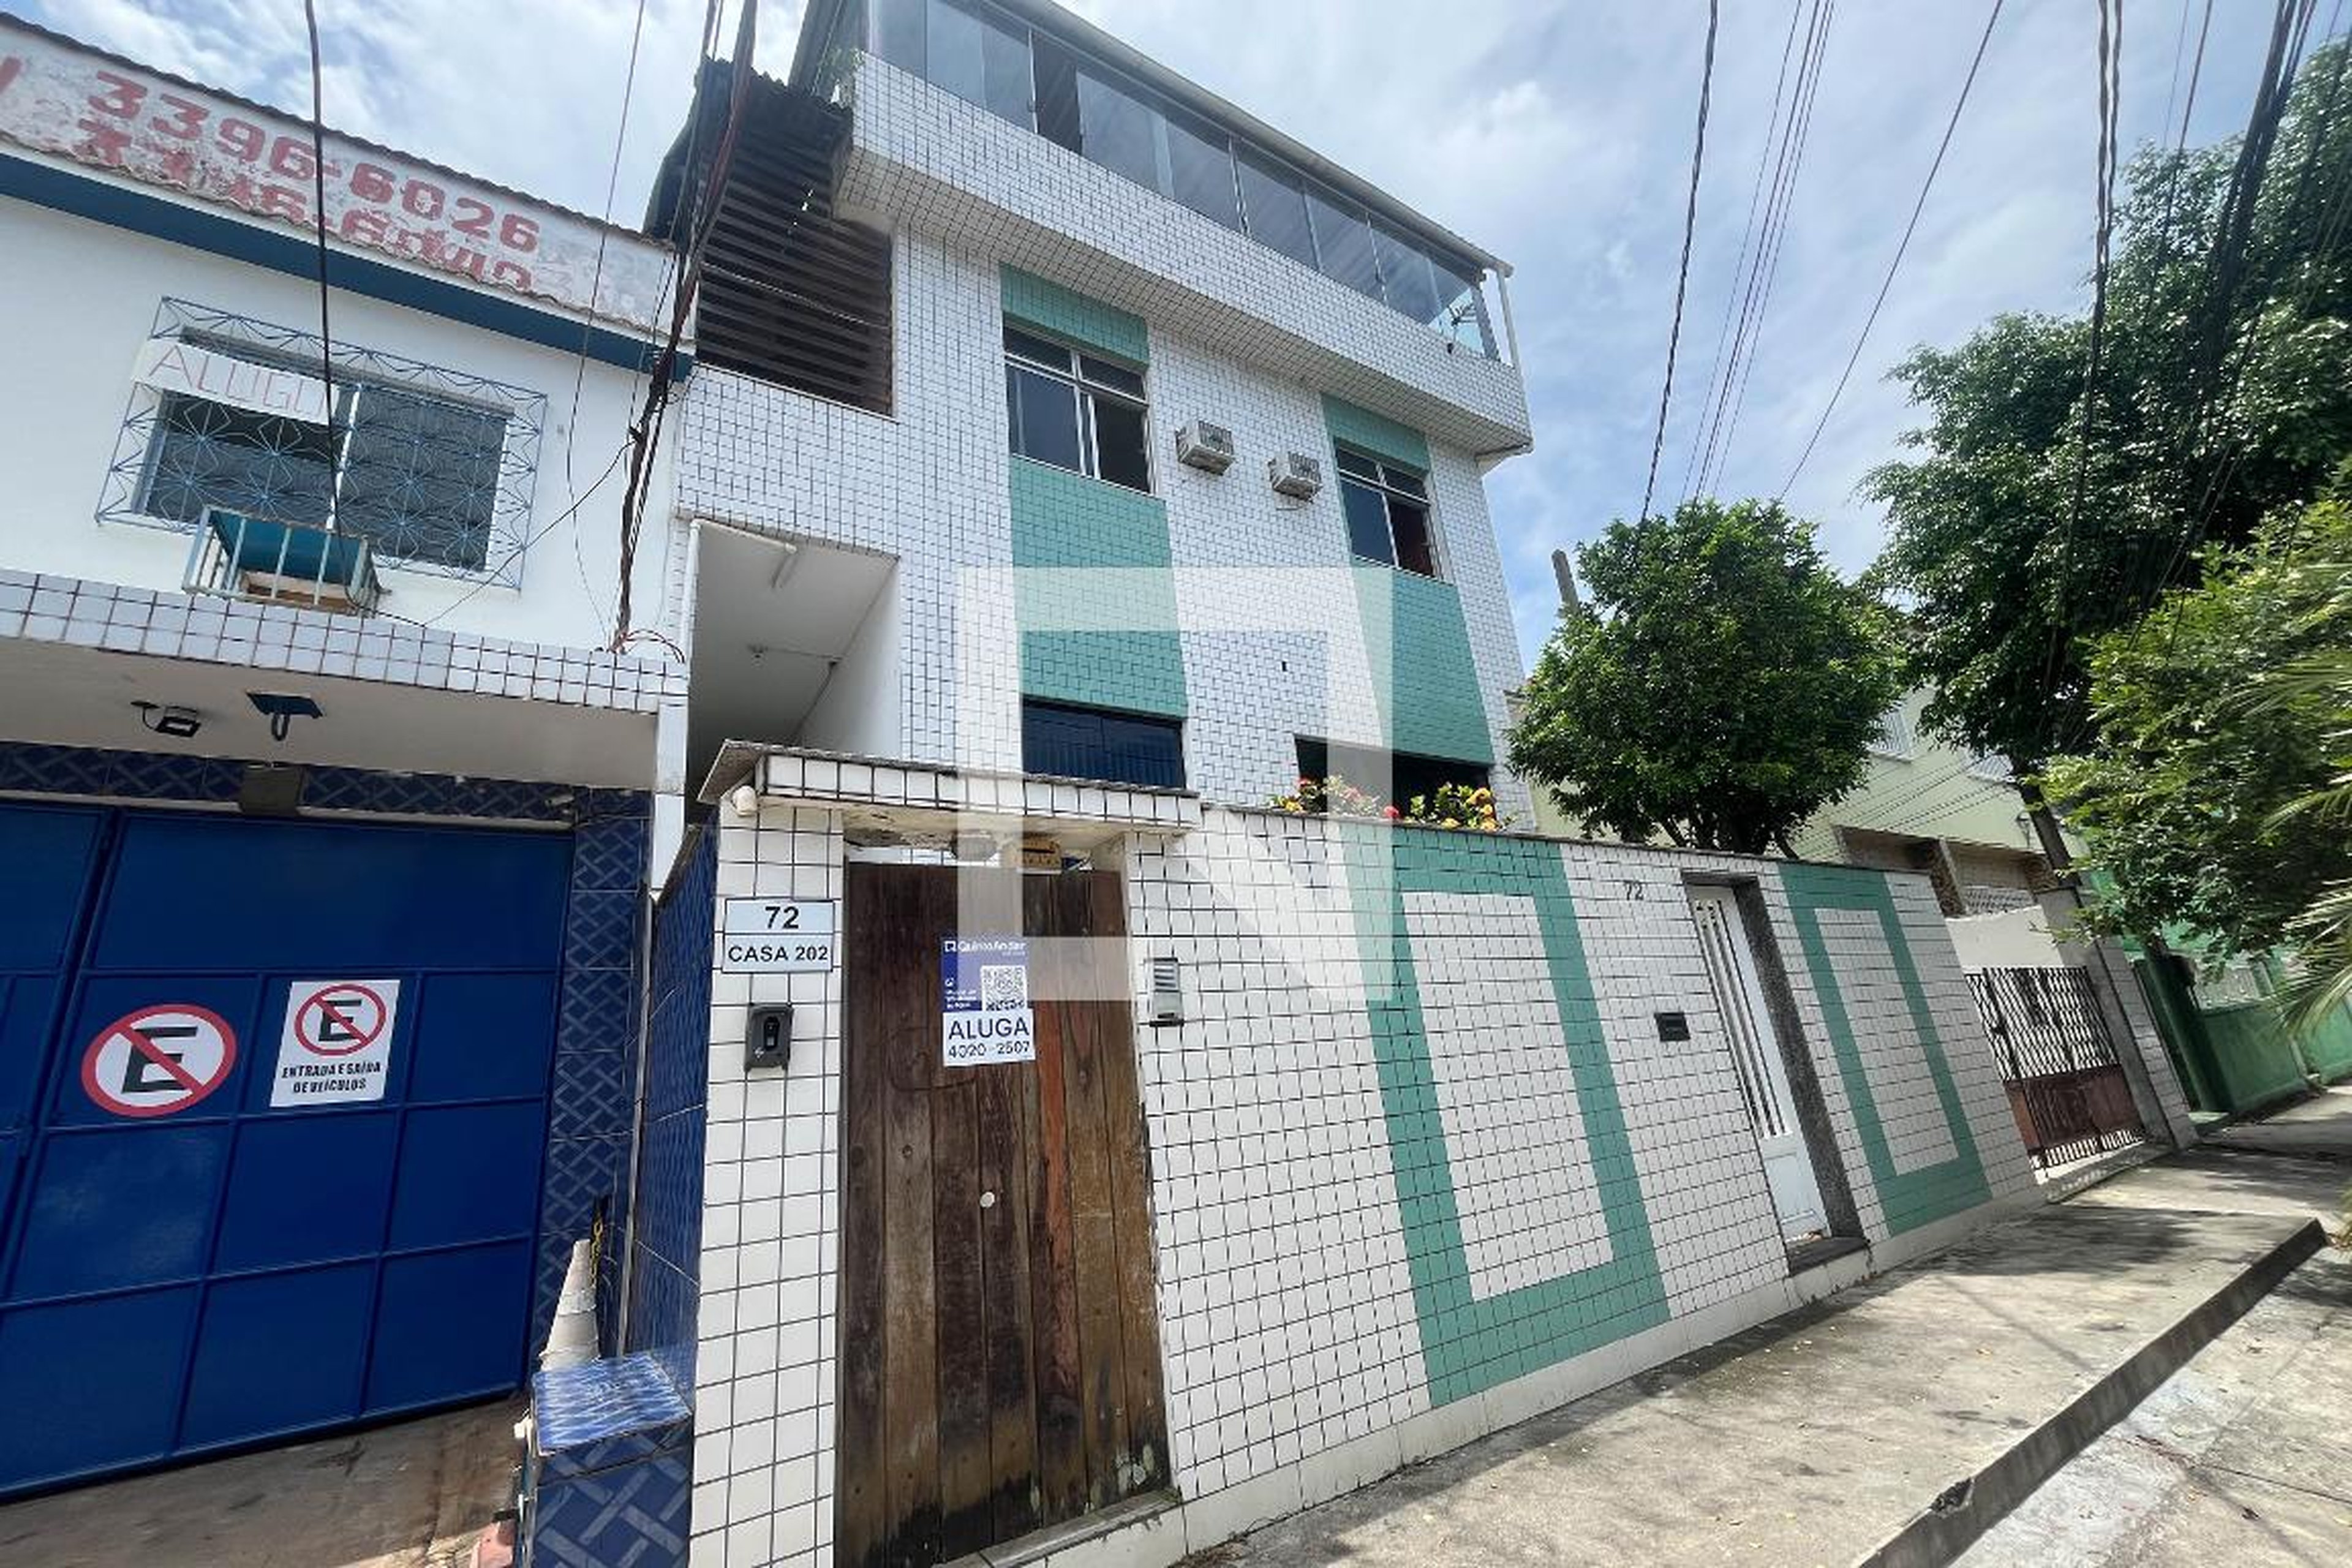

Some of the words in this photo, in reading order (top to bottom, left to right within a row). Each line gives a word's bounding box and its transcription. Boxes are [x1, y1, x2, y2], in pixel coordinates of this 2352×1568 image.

[1624, 880, 1645, 901] 72
[765, 906, 799, 930] 72
[728, 945, 789, 963] CASA
[794, 946, 829, 962] 202
[948, 1017, 1030, 1041] ALUGA
[281, 1064, 336, 1079] ENTRADA
[293, 1082, 307, 1094] DE
